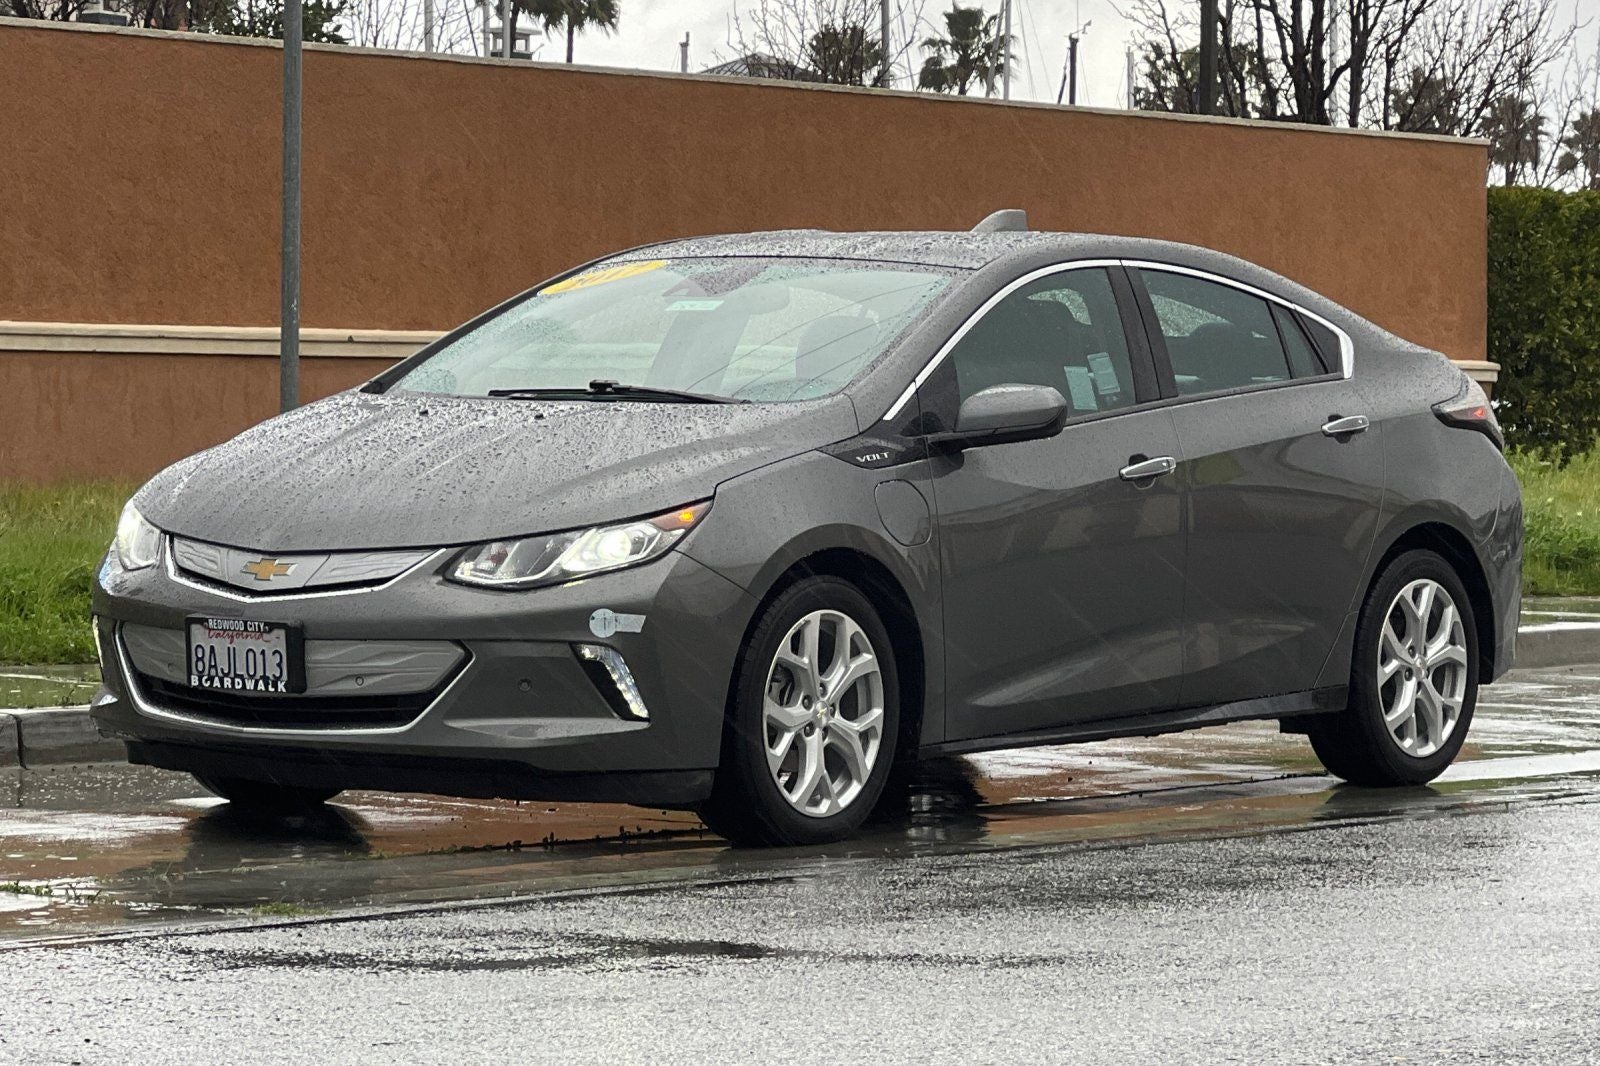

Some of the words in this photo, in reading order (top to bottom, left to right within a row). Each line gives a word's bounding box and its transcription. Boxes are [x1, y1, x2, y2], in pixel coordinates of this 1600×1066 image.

[856, 452, 889, 462] VOLT
[208, 619, 244, 630] REDWOOD
[247, 622, 265, 631] CITY
[208, 629, 270, 644] California
[195, 644, 283, 679] 8AJL013
[191, 675, 286, 692] BOARDWALK
